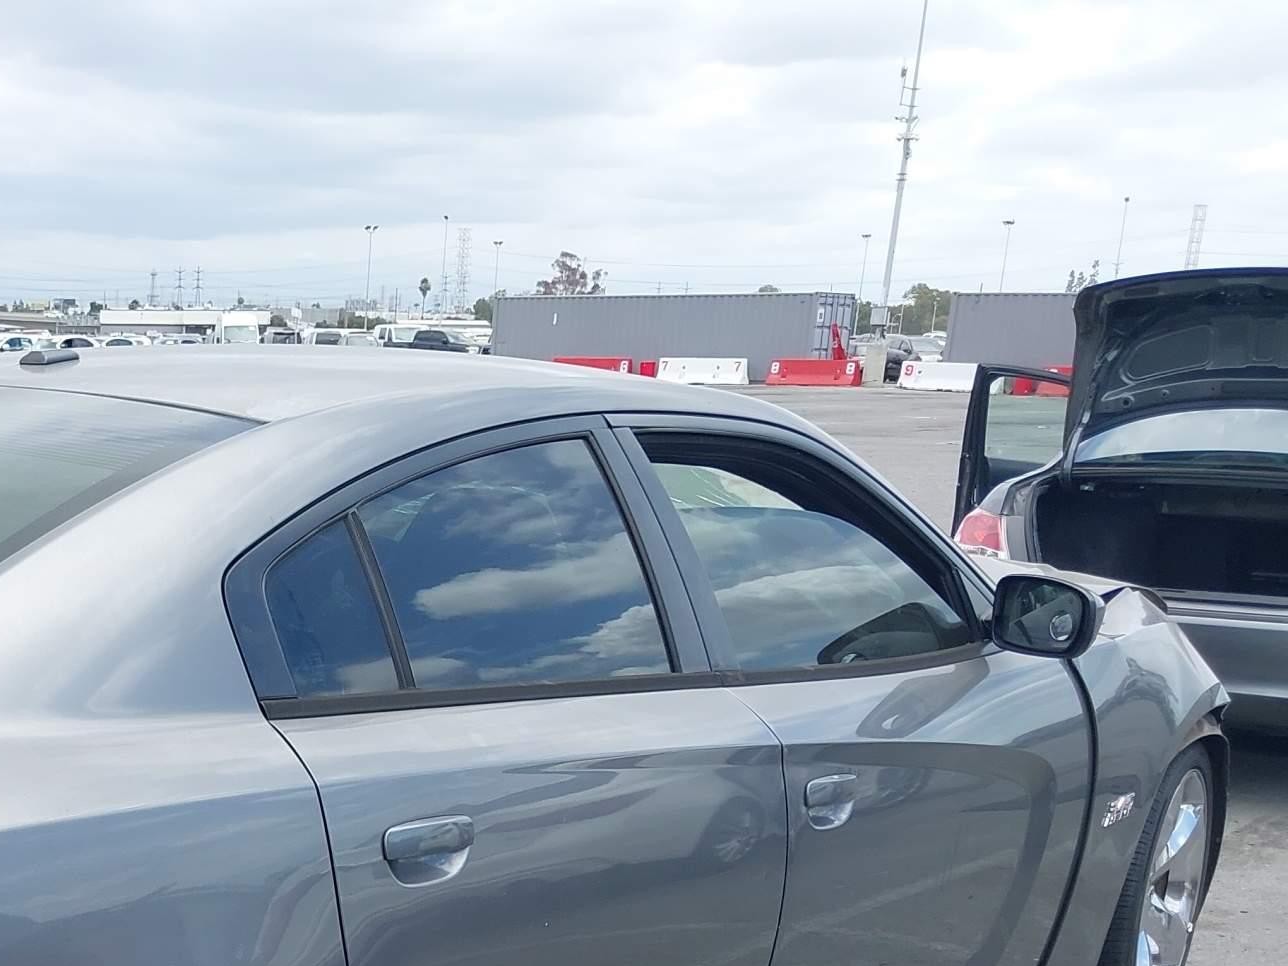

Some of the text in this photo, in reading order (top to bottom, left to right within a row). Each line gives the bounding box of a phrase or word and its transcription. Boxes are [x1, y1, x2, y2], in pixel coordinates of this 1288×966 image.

[662, 360, 670, 371] 7
[734, 361, 742, 373] 7
[770, 361, 780, 374] 8
[845, 361, 855, 375] 8
